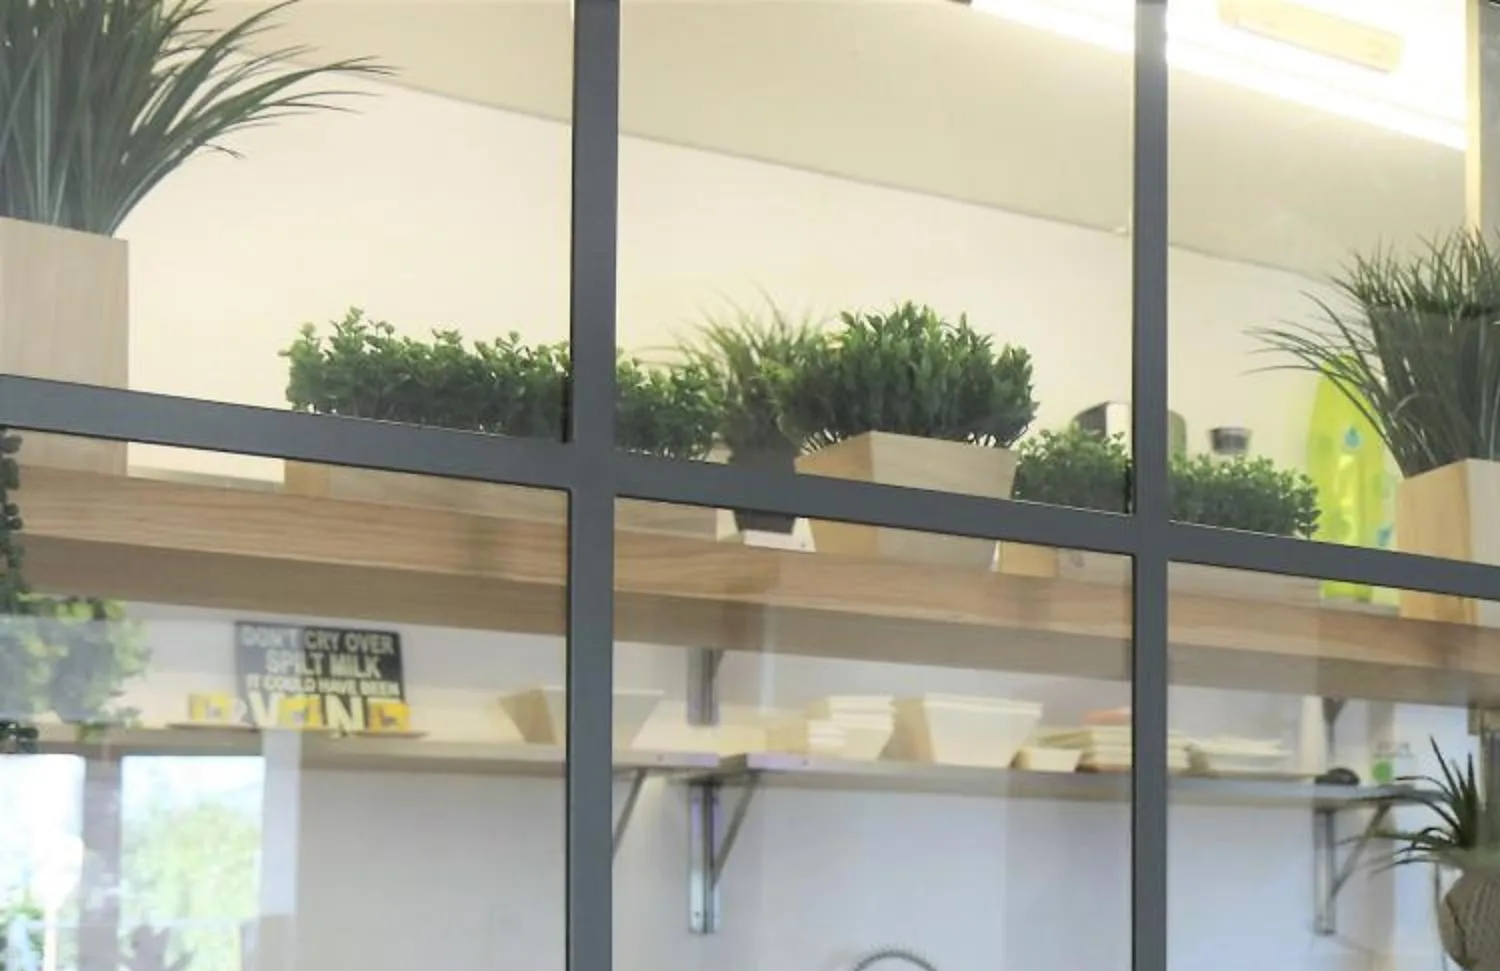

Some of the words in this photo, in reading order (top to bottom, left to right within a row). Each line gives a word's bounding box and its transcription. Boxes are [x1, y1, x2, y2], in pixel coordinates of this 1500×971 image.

[305, 631, 340, 650] CRY
[345, 632, 395, 655] OVER
[265, 649, 325, 675] SPILT
[329, 653, 382, 679] MILK
